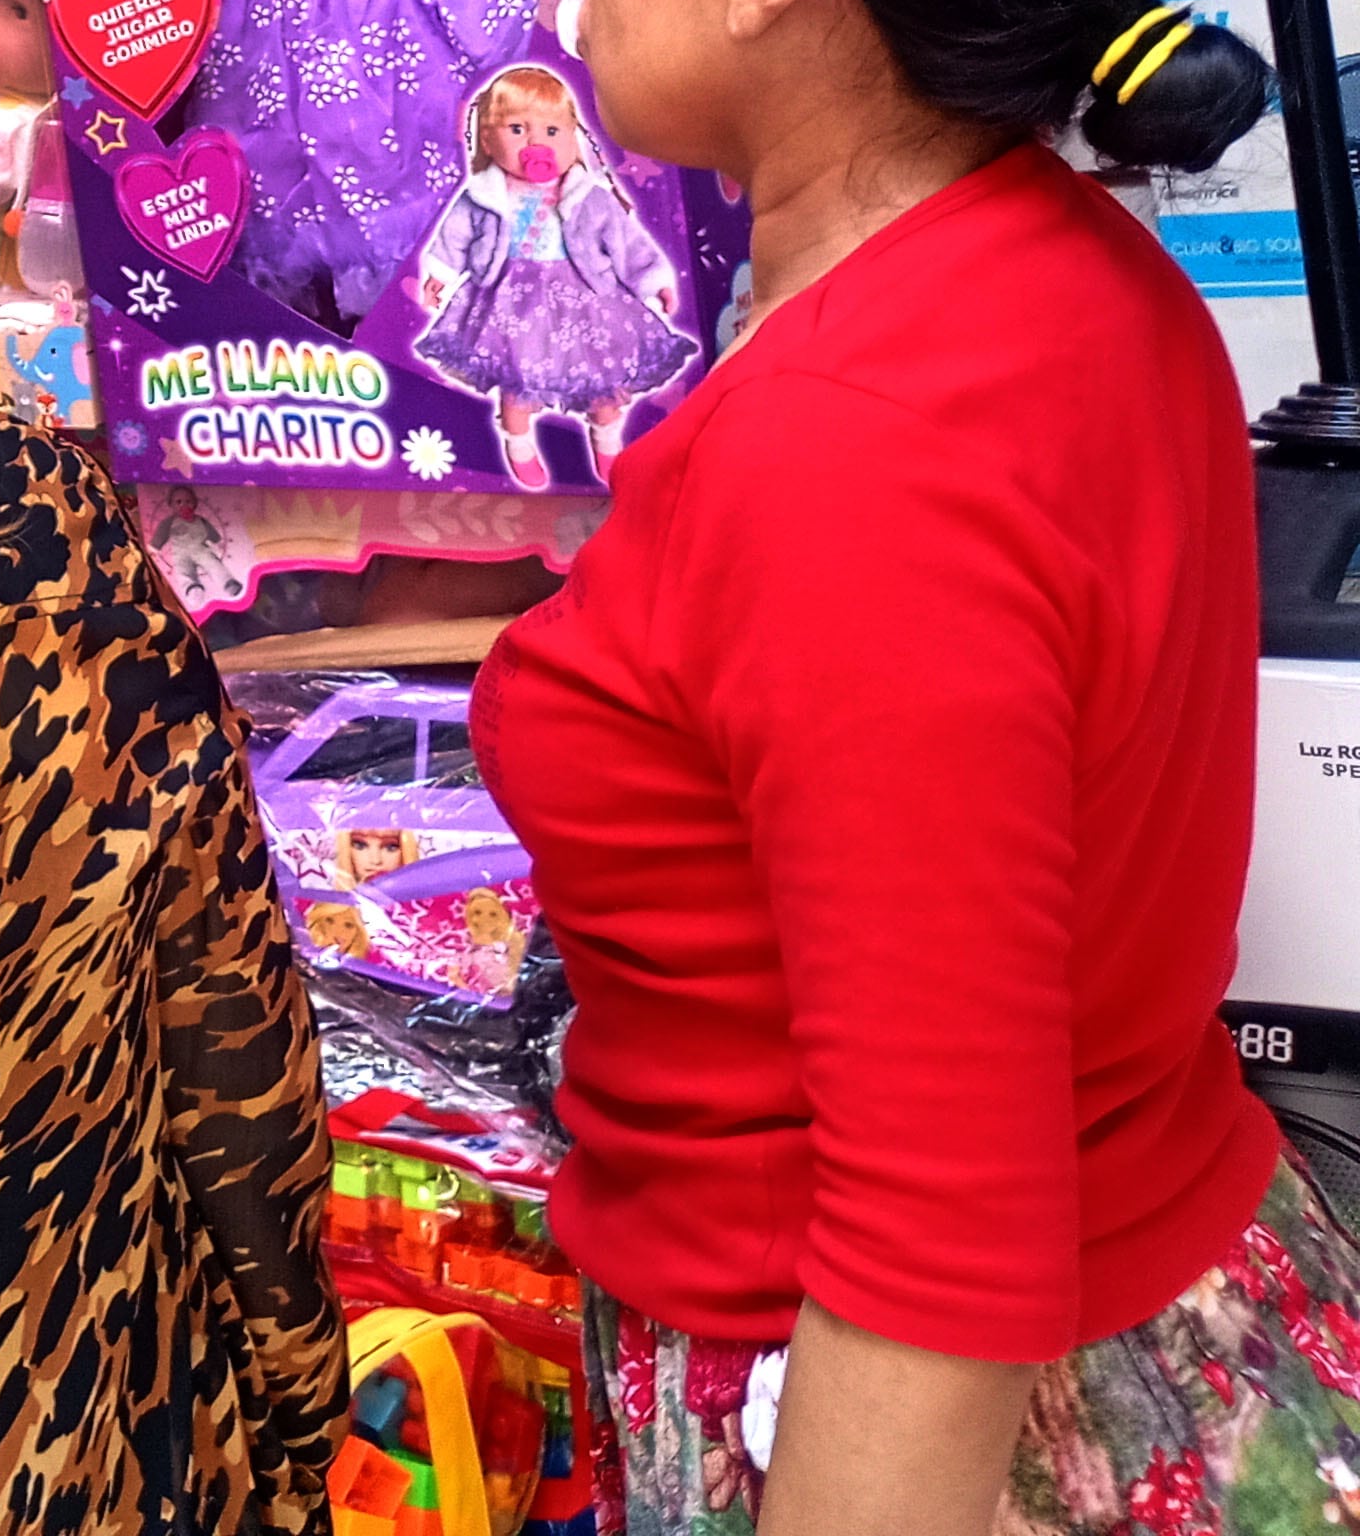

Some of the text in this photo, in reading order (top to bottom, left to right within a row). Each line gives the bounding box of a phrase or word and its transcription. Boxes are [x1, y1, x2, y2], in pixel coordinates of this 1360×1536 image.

[106, 6, 173, 46] JUGAR
[140, 176, 208, 218] ESTOY
[162, 197, 209, 231] MUY
[164, 213, 231, 251] LINDA
[147, 344, 381, 405] ME LLAMO
[185, 412, 385, 462] CHARITO
[1299, 741, 1333, 758] Luz
